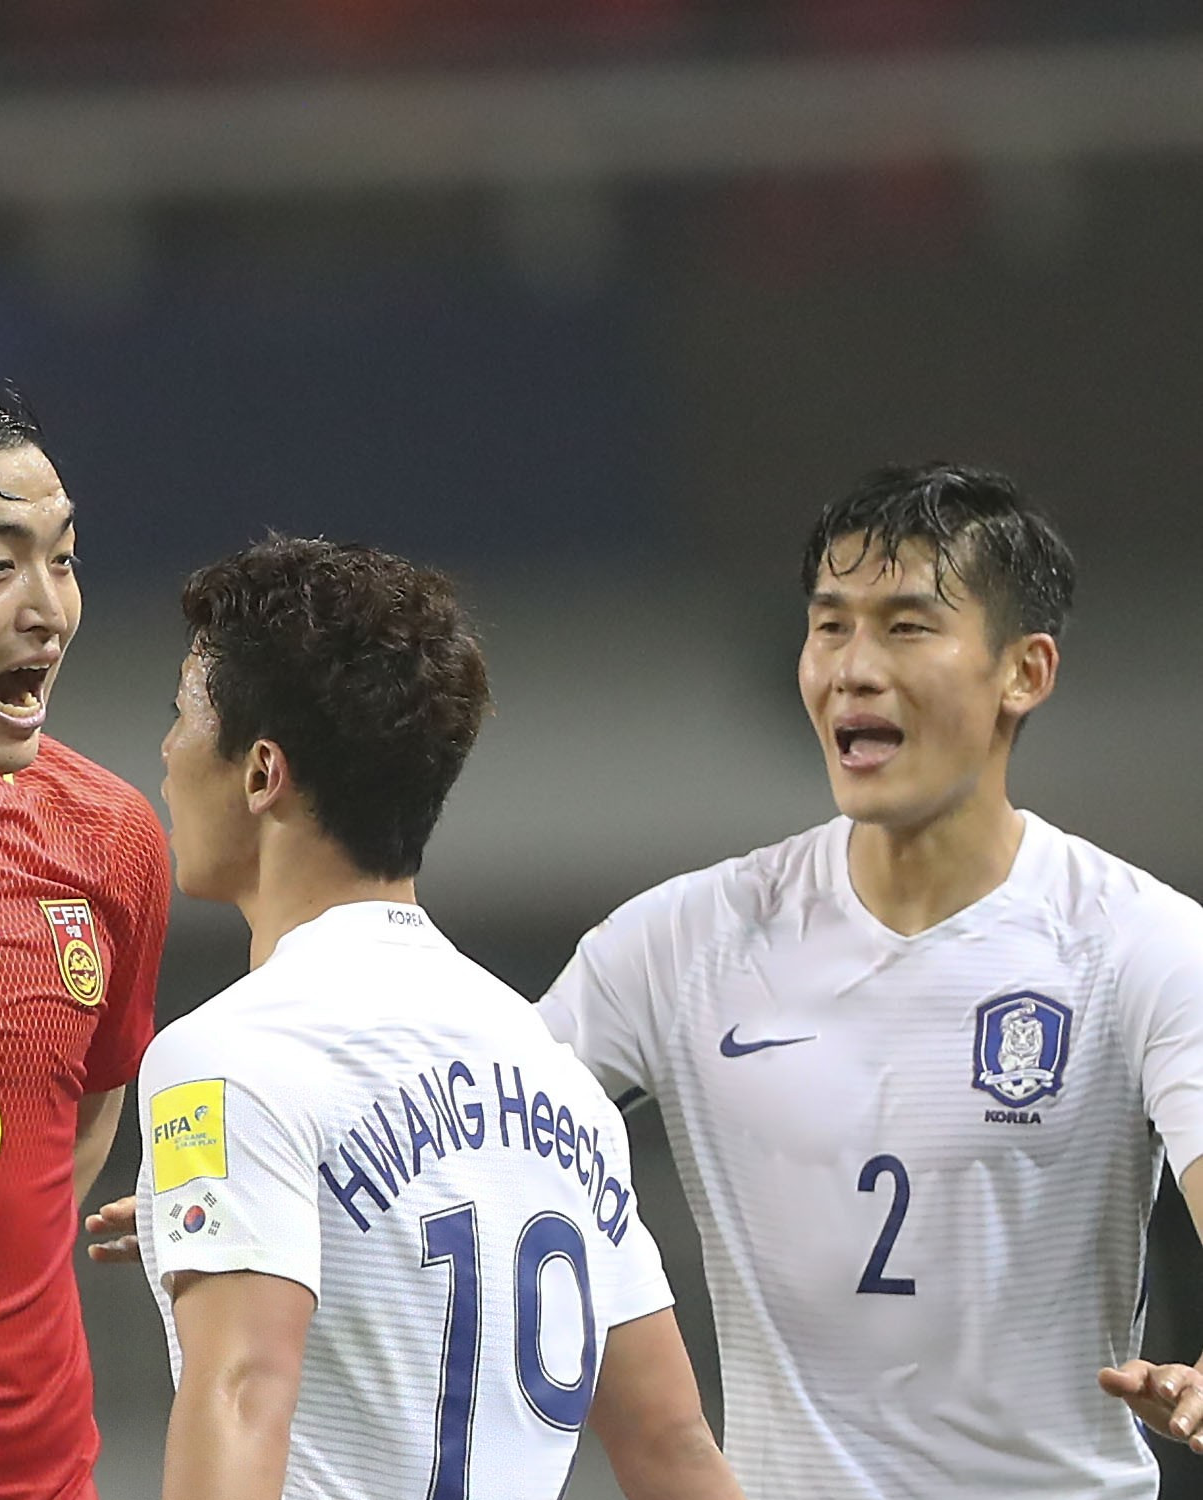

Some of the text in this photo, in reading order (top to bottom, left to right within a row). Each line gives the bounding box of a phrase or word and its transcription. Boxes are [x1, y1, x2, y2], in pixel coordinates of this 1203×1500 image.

[47, 906, 90, 925] CFA
[387, 909, 425, 927] KOREA
[984, 1109, 1041, 1124] KOREA
[154, 1116, 191, 1144] FIFA
[318, 1060, 485, 1233] HWANG
[855, 1153, 916, 1295] 2
